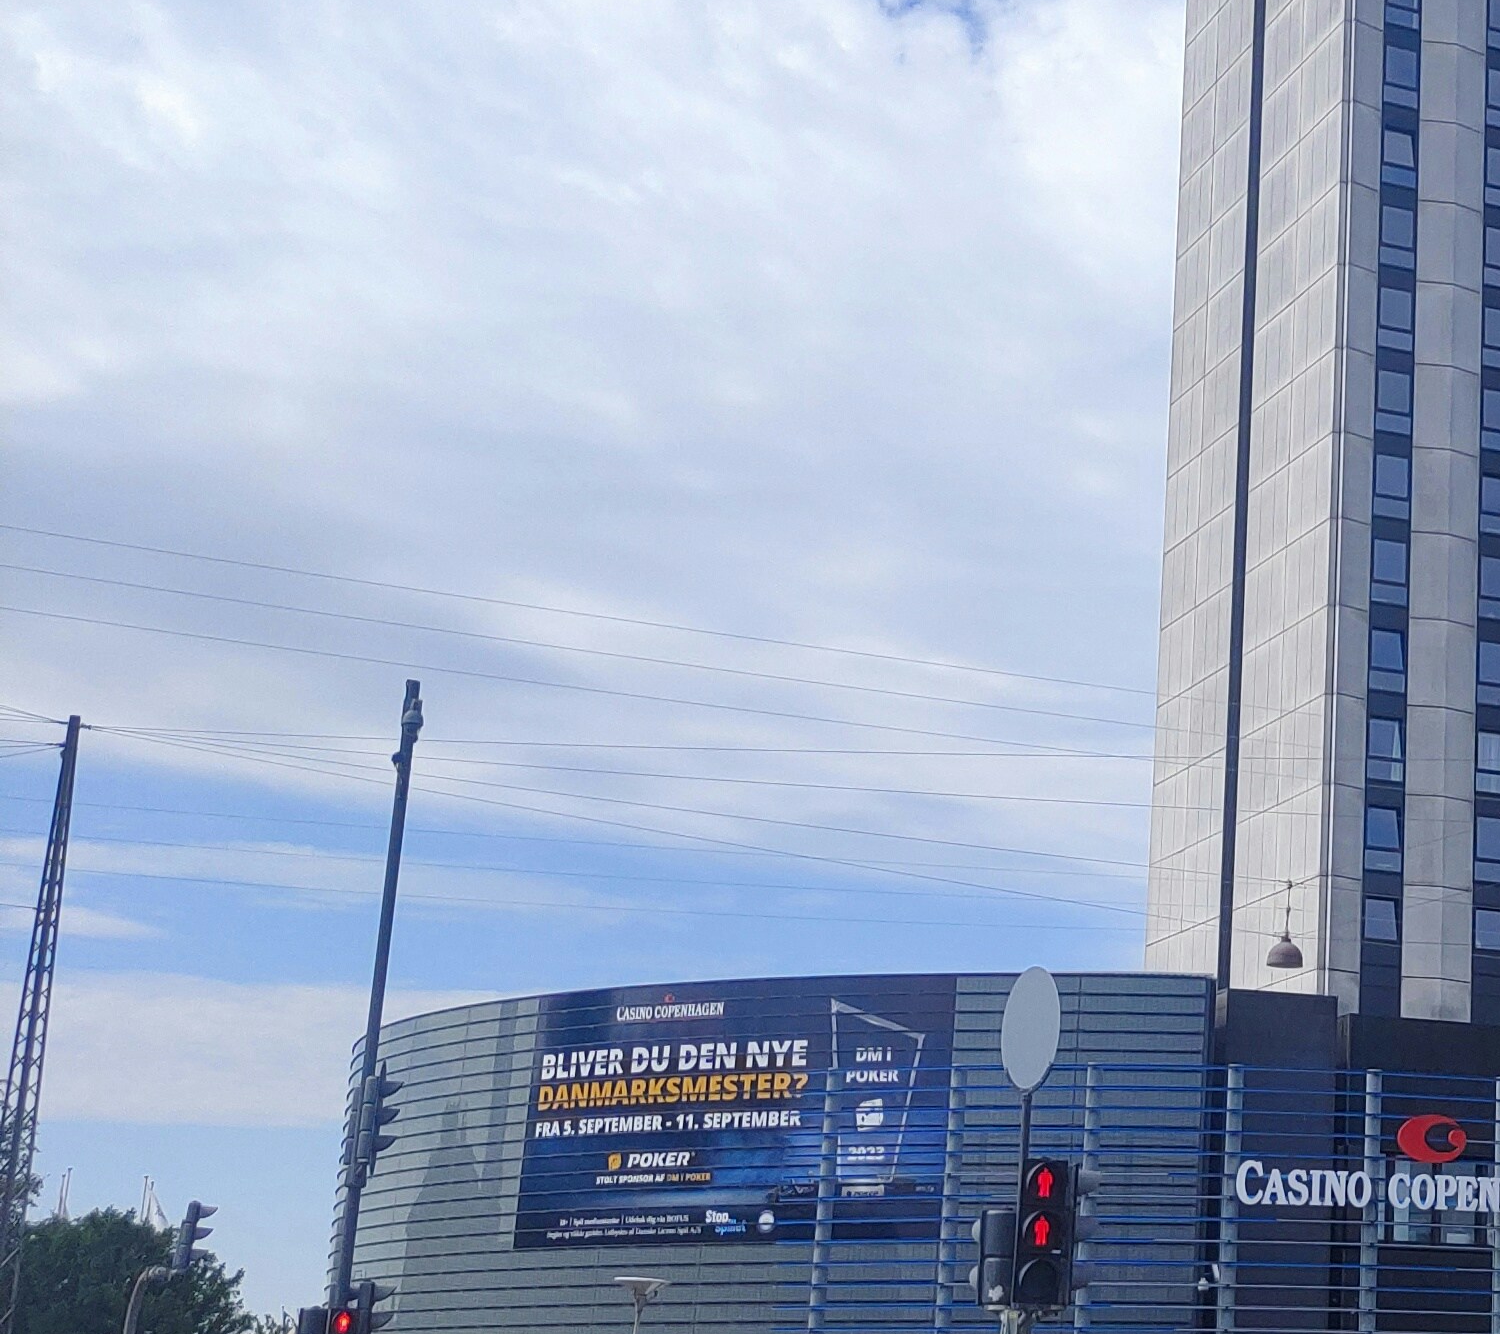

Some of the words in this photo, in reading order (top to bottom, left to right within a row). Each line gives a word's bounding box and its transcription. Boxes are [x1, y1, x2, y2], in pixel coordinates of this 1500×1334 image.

[616, 1006, 653, 1021] CASINO
[654, 1002, 725, 1018] COPENHAGEN
[541, 1048, 624, 1080] BLIVER
[630, 1045, 671, 1074] DU
[678, 1042, 738, 1070] DEN
[745, 1039, 809, 1068] NYE
[856, 1046, 883, 1062] DM
[846, 1069, 899, 1083] POKER
[537, 1072, 809, 1112] DANMARKSMESTER?
[535, 1120, 560, 1138] FRA
[563, 1120, 575, 1136] 5.
[578, 1115, 663, 1135] SEPTEMBER
[676, 1113, 699, 1131] 11.
[703, 1110, 802, 1129] SEPTEMBER
[627, 1151, 692, 1168] POKER
[618, 1173, 654, 1184] SPONSOR
[1235, 1160, 1372, 1208] CASINO
[705, 1209, 729, 1224] Stop
